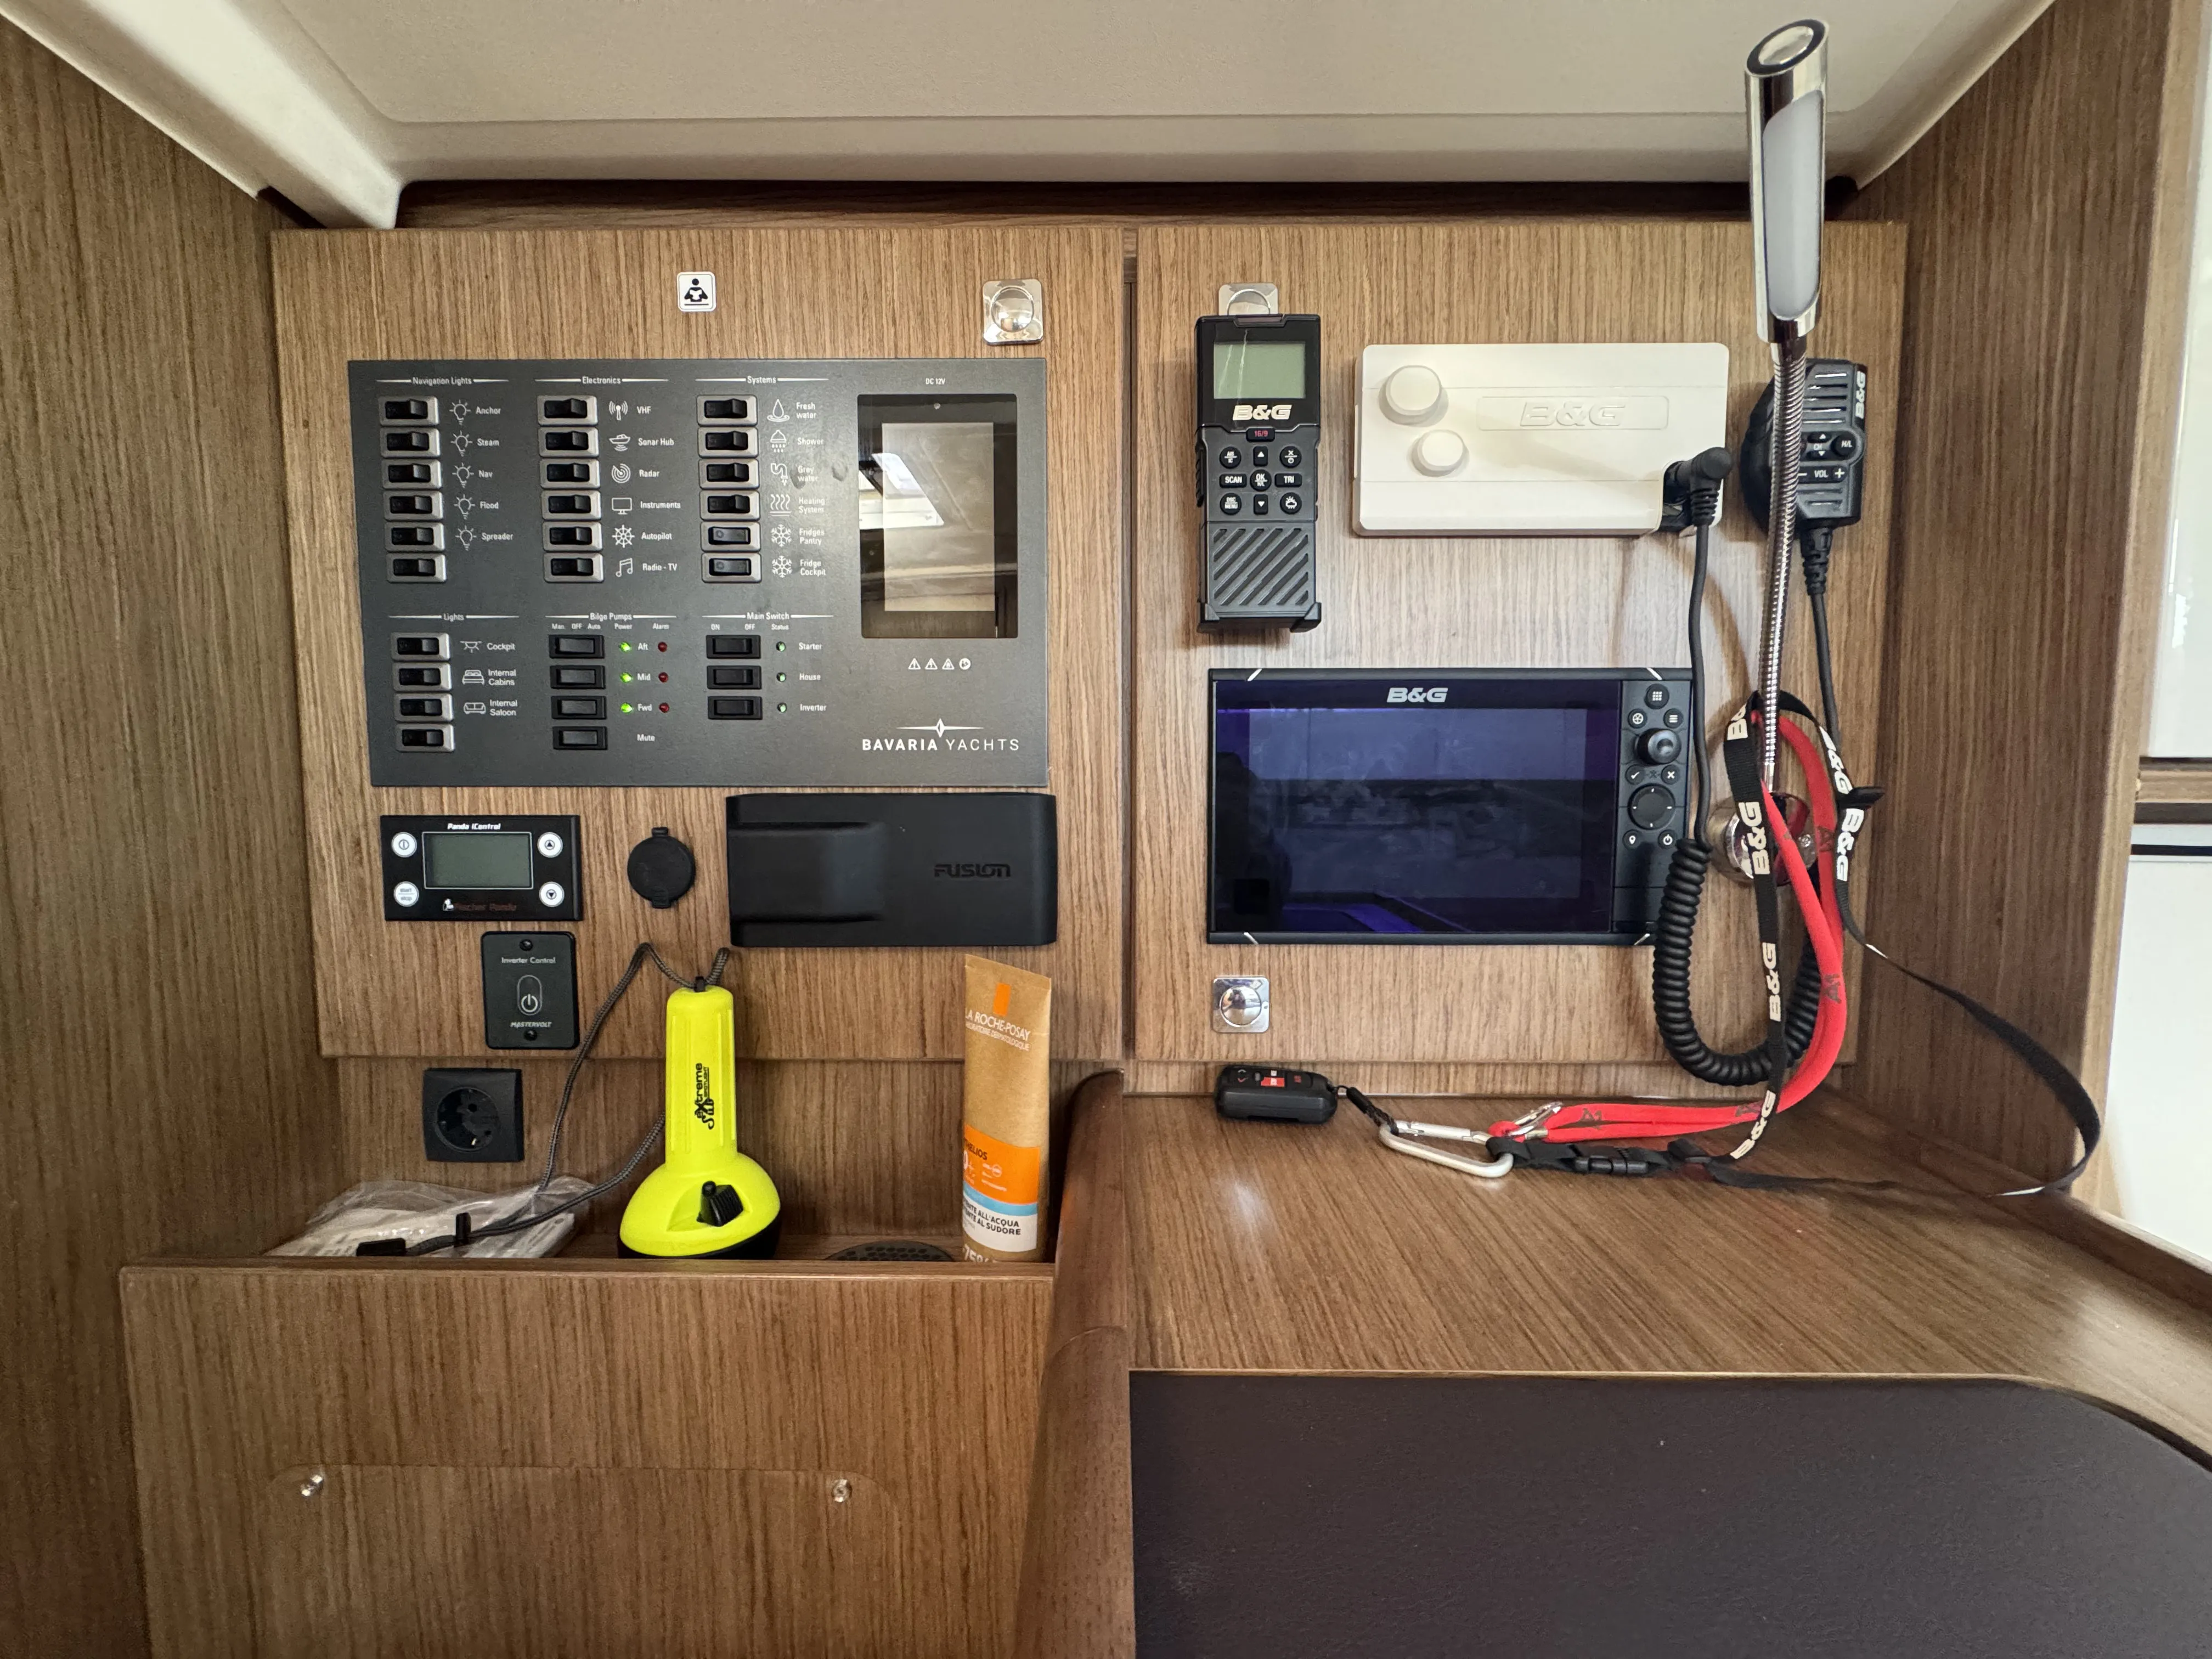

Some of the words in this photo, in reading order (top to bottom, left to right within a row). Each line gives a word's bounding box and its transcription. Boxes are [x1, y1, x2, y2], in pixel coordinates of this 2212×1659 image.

[413, 377, 450, 385] Navigation
[451, 377, 472, 385] Lights
[747, 376, 776, 384] Systems
[1855, 371, 1866, 419] B&G
[797, 402, 815, 410] Fresh
[1233, 404, 1292, 420] B&G
[1520, 402, 1625, 426] B&G
[477, 438, 499, 447] Steam
[798, 466, 814, 475] Grey
[798, 497, 825, 506] Heating
[799, 505, 823, 514] System
[482, 532, 514, 541] Spreader
[641, 532, 672, 541] Autopilot
[799, 528, 825, 537] Fridges
[799, 537, 822, 546] Pantry
[800, 560, 821, 568] Fridge
[800, 568, 826, 577] Cockpit
[443, 613, 464, 622] Lights
[590, 613, 607, 622] Bilge
[609, 613, 633, 622] Pumps
[747, 612, 764, 620] Main
[766, 612, 789, 620] Switch
[487, 642, 515, 651] Cockpit
[799, 642, 822, 651] Starter
[799, 673, 821, 681] House
[1387, 687, 1448, 703] B&G
[489, 699, 517, 708] Internal
[637, 703, 652, 712] Fwd
[800, 703, 827, 712] Inverter
[1726, 703, 1748, 741] B&
[862, 738, 938, 751] BAVARIA
[946, 738, 1019, 751] YACHTS
[471, 822, 501, 831] iControl
[1738, 802, 1771, 875] B&G
[1836, 808, 1864, 882] B&G
[934, 863, 1011, 878] FUSION
[1762, 942, 1781, 1022] B&G
[974, 1011, 1031, 1041] ROCHE-POSAY
[1730, 1090, 1776, 1159] B&G
[978, 1210, 1019, 1227] ALL'ACQUA
[977, 1218, 985, 1227] AL
[986, 1222, 1022, 1235] SUDORE
